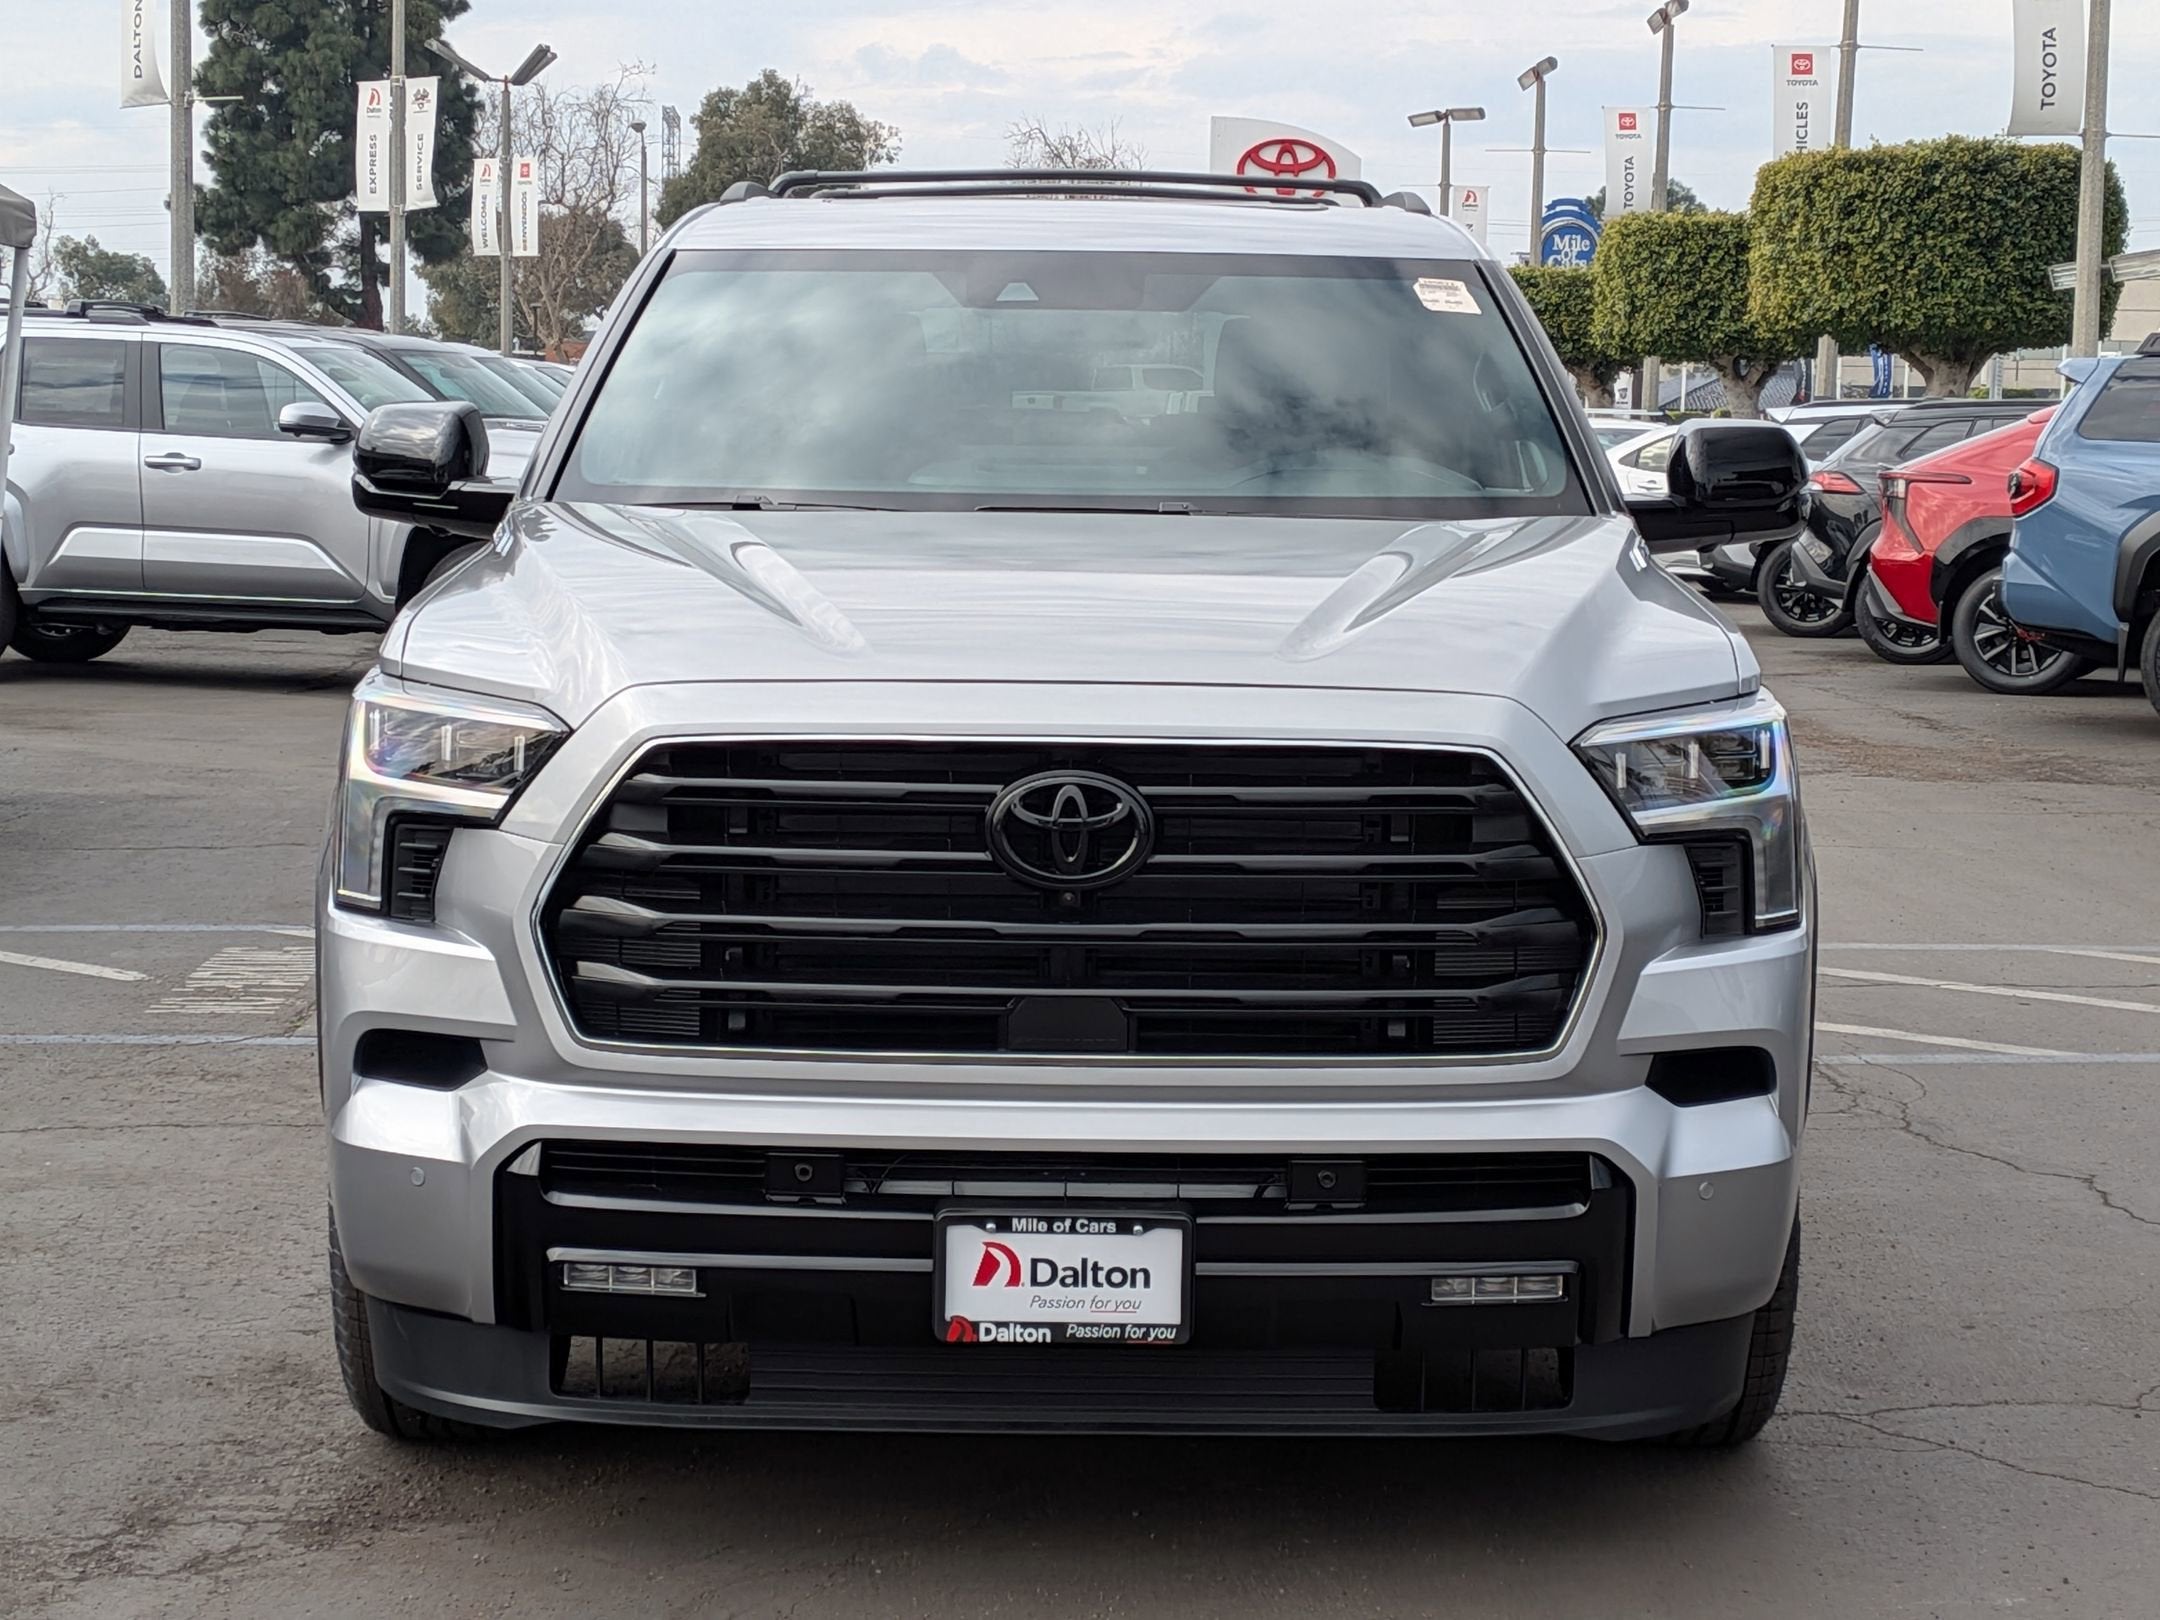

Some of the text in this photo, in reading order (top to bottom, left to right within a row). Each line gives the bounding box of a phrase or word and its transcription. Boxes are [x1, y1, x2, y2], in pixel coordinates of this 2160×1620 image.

[2040, 27, 2057, 111] TOYOTA
[369, 134, 377, 194] EXPRESS
[416, 133, 424, 191] SERVICE
[1623, 156, 1634, 209] TOYOTA
[480, 194, 488, 249] WELCOME
[1551, 234, 1591, 251] Mile
[1561, 248, 1578, 261] of
[1011, 1217, 1117, 1234] Mile of Cars
[1030, 1257, 1151, 1289] Dalton
[1029, 1295, 1142, 1312] Passion for you
[979, 1323, 1177, 1343] Dalton Passion for you
